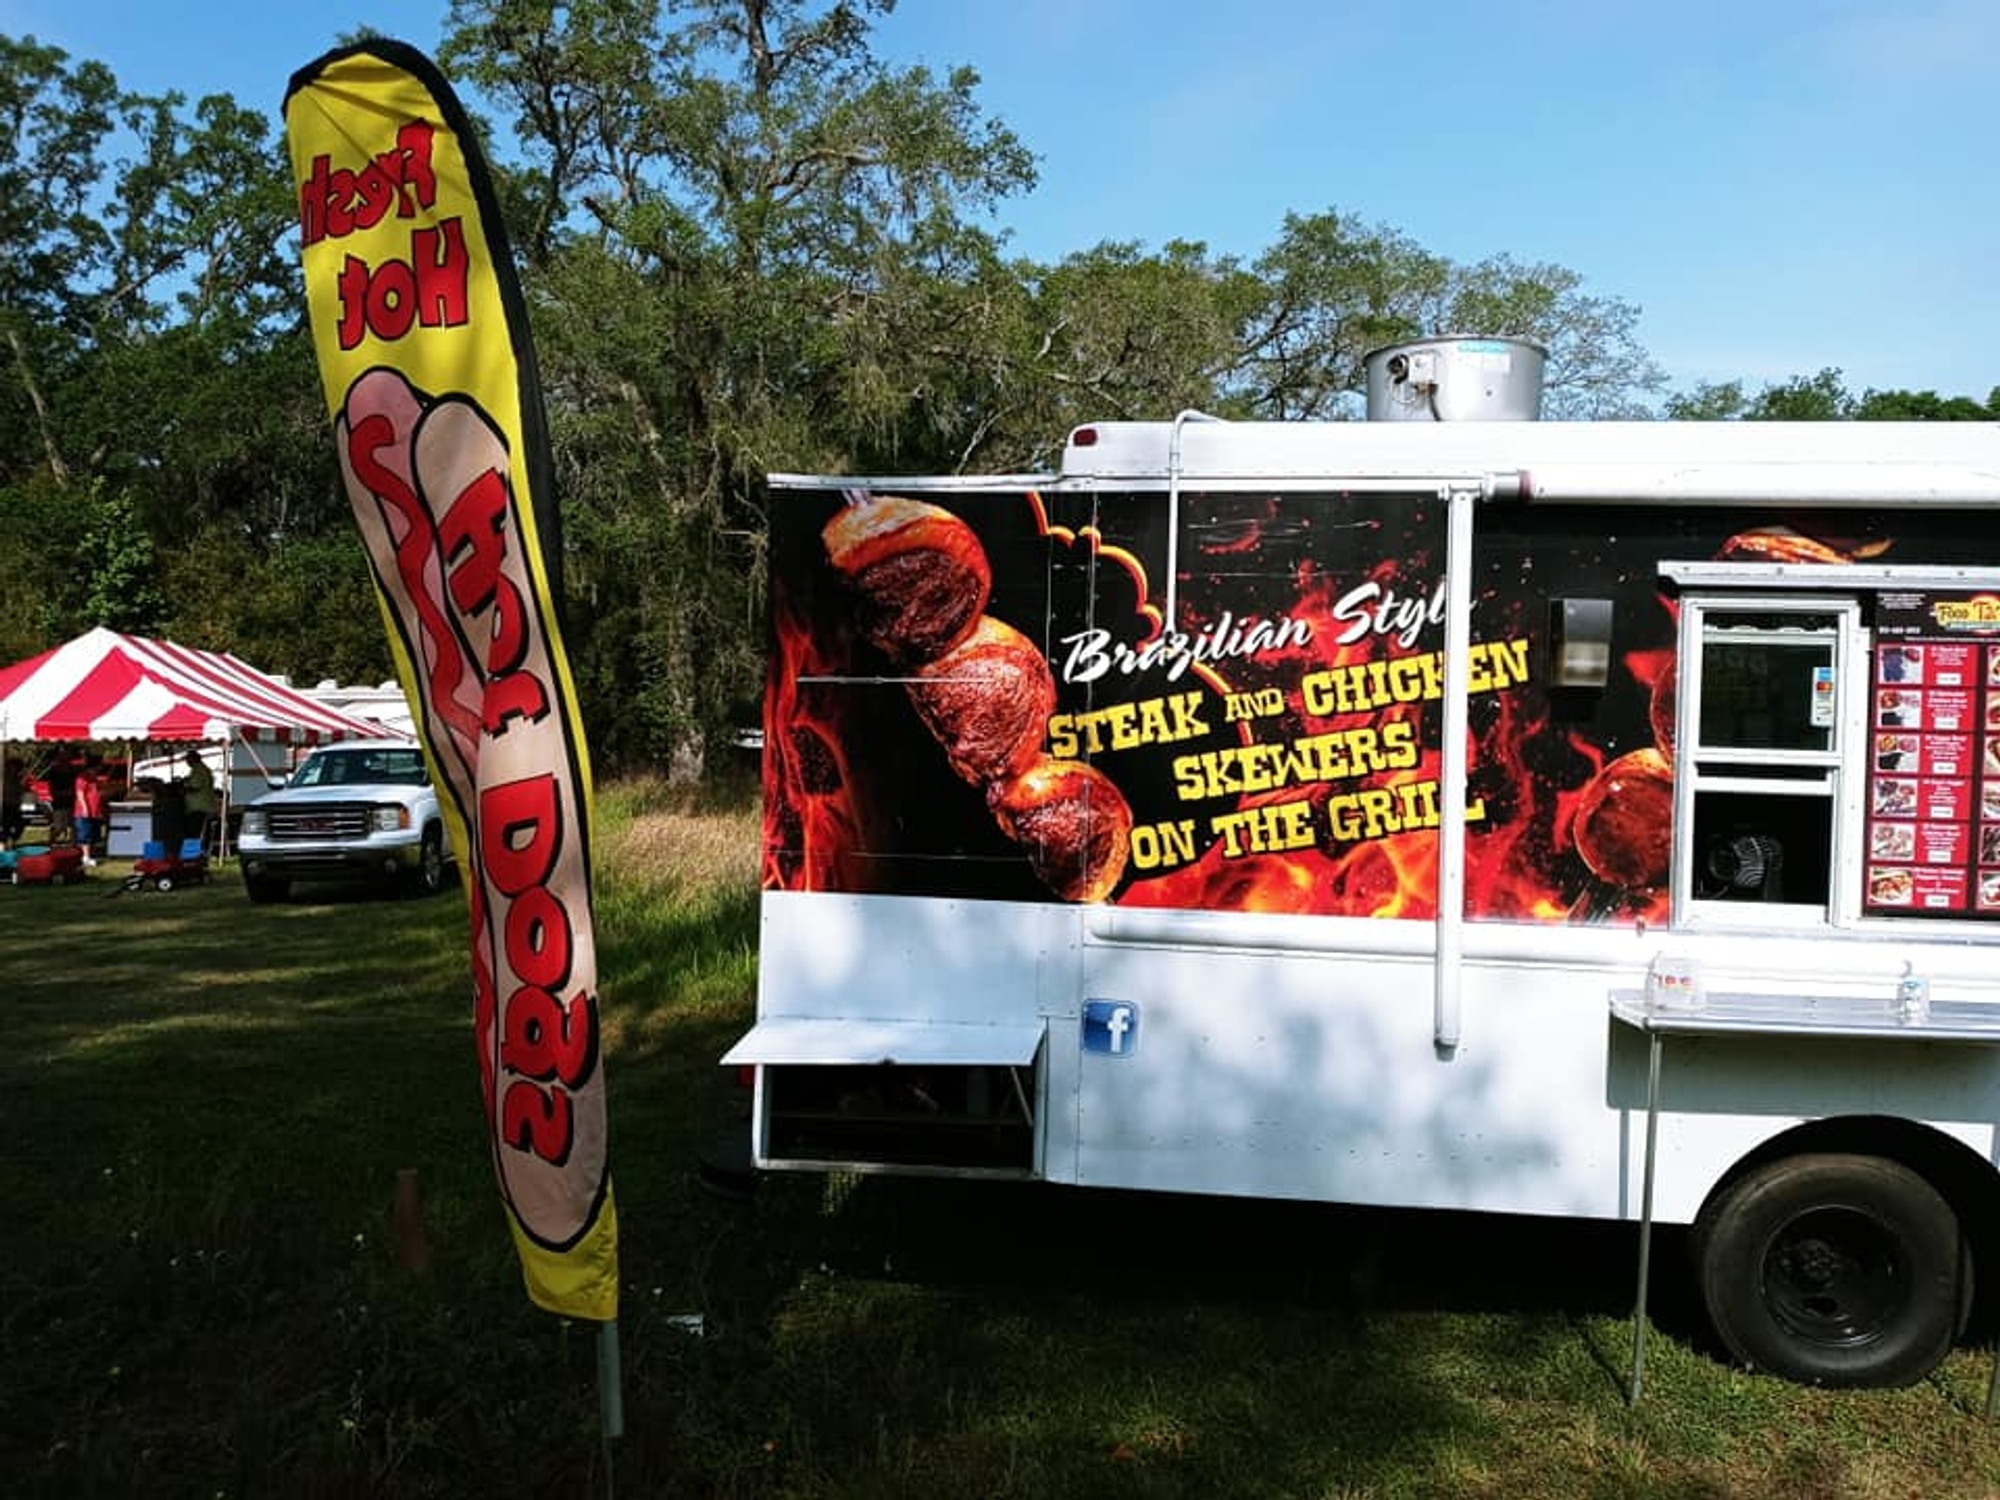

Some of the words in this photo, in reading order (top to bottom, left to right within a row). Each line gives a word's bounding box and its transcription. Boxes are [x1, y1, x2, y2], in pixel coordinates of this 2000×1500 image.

[1061, 608, 1314, 684] Brazilian
[1334, 581, 1477, 649] Styl
[1048, 692, 1210, 759] STEAK
[1224, 687, 1285, 724] AND
[1173, 723, 1417, 802] SKEWERS
[1130, 820, 1197, 871] ON
[1212, 800, 1317, 859] THE
